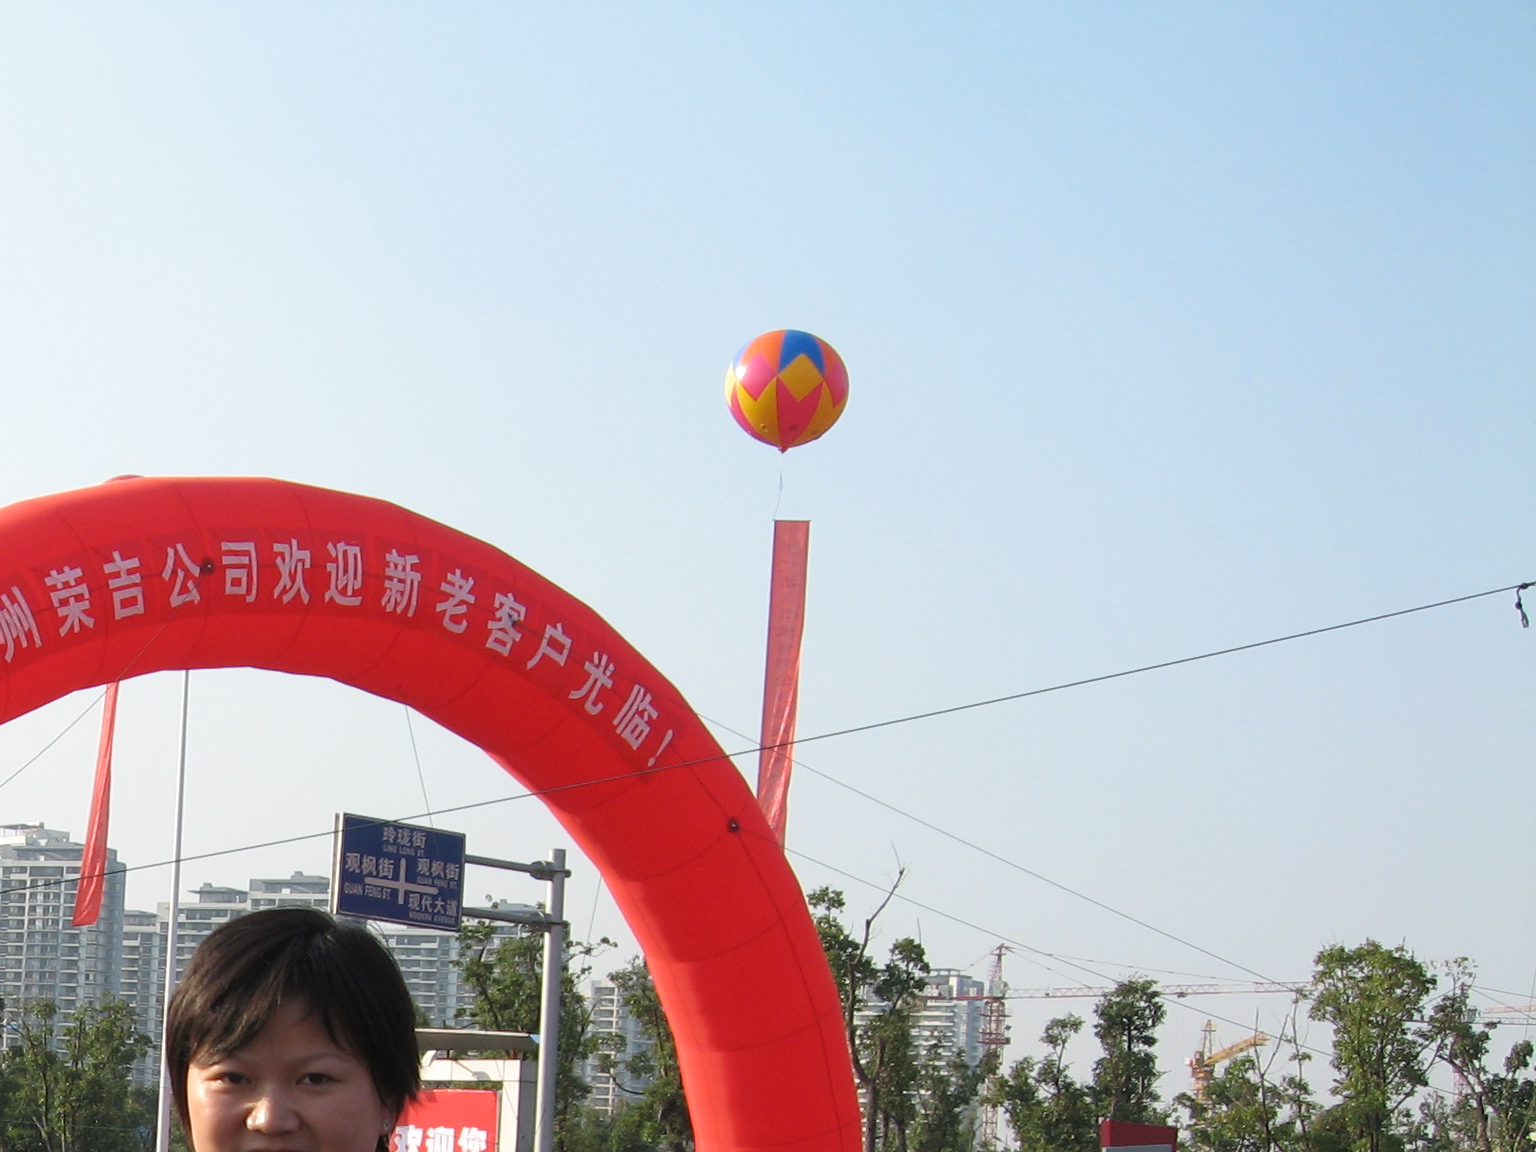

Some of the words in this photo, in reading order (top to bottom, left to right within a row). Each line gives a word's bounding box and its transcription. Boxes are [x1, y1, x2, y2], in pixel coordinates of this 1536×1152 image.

[383, 826, 427, 848] 玲珑街
[345, 852, 395, 879] 观枫街
[416, 858, 461, 880] 观枫街
[343, 882, 364, 896] GUAN
[408, 893, 459, 917] 现代大道
